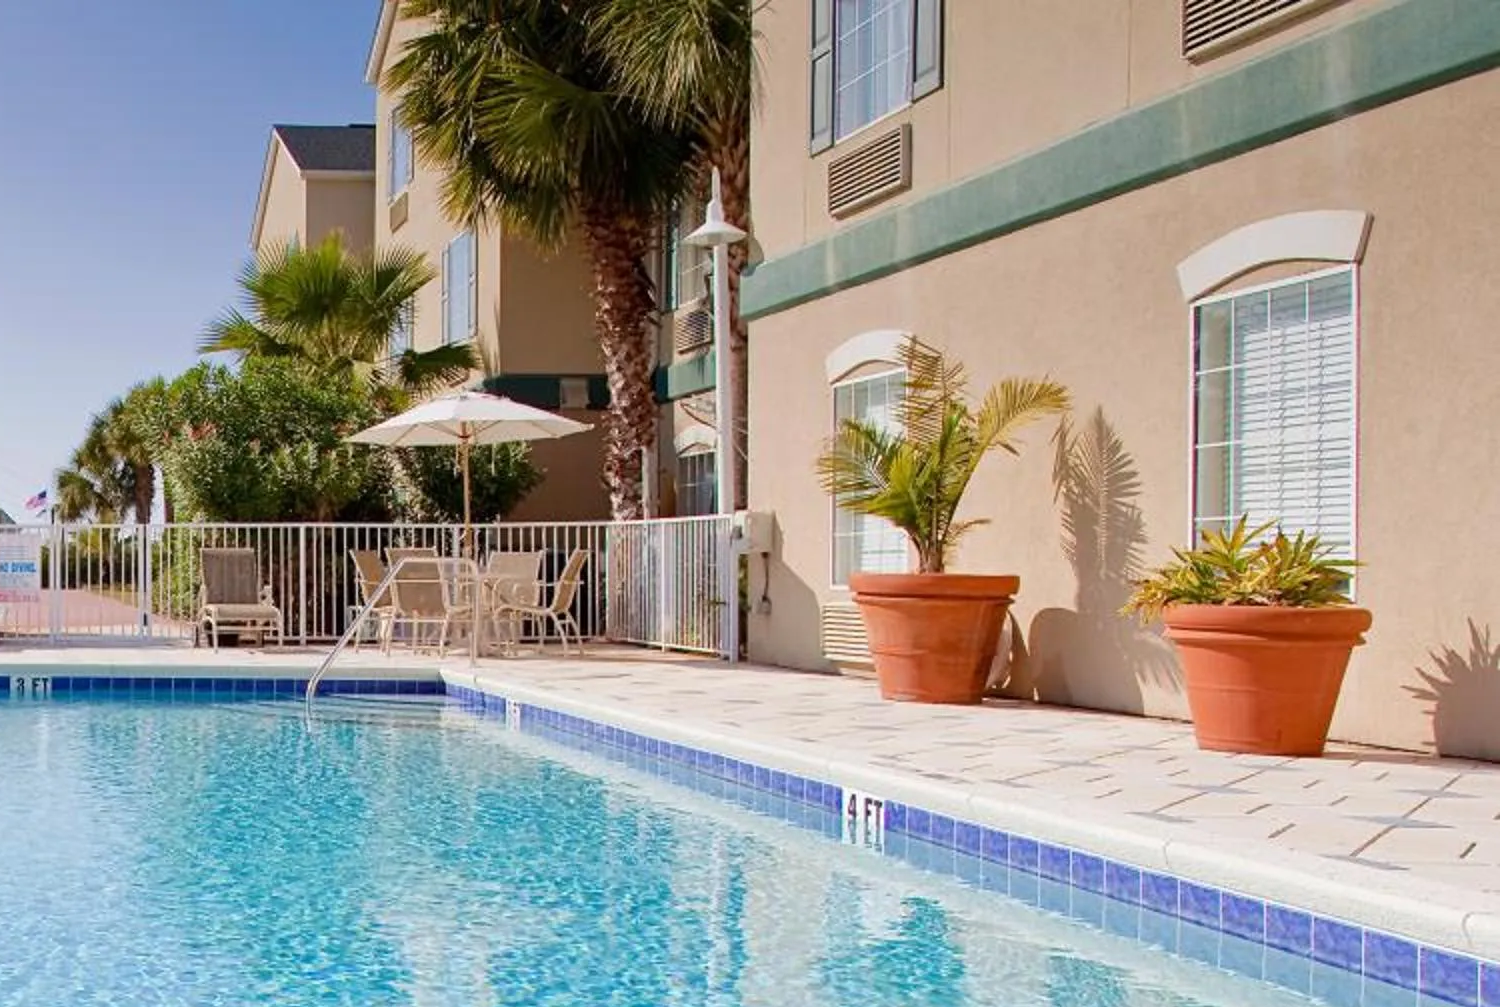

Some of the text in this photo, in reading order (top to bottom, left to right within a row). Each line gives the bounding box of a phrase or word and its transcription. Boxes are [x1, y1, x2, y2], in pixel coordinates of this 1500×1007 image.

[31, 678, 49, 691] FT
[847, 794, 883, 825] 4 FT
